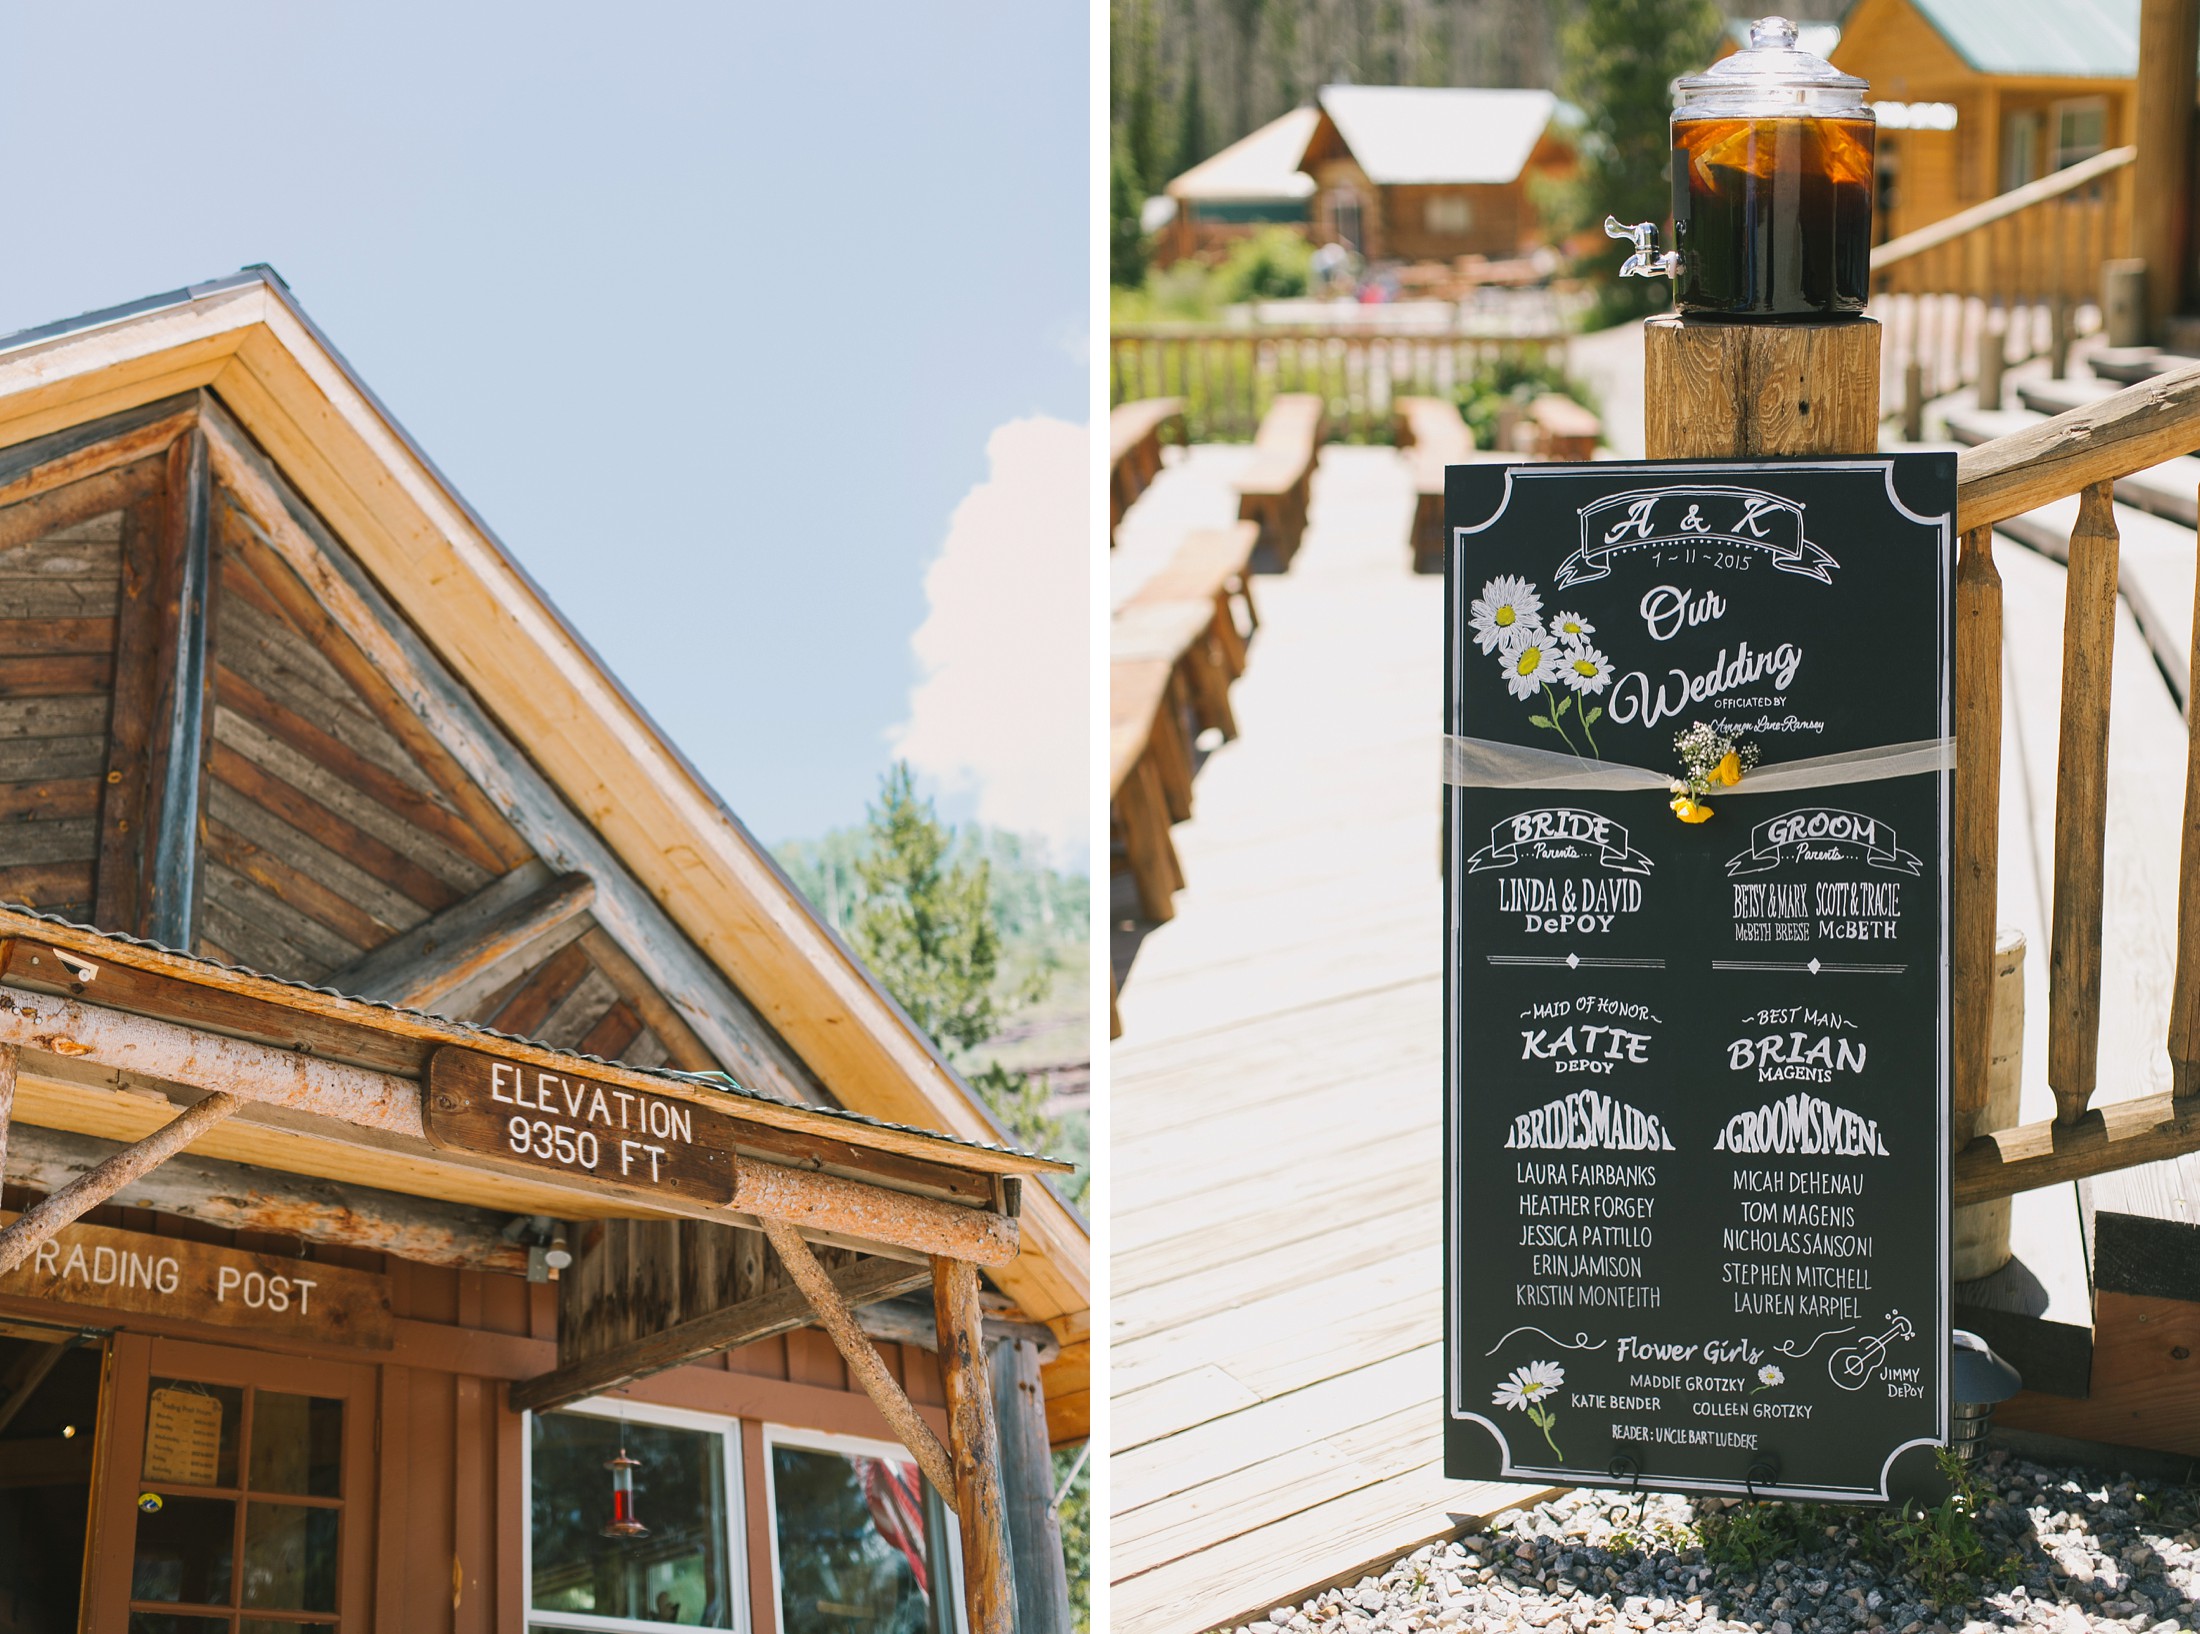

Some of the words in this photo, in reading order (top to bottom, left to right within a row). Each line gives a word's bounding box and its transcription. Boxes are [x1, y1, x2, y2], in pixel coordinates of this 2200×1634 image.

[1604, 498, 1659, 544] A
[1680, 504, 1711, 533] &
[1731, 498, 1786, 538] K
[1640, 585, 1726, 641] Our
[1608, 641, 1802, 728] Wedding
[1714, 698, 1773, 709] OFFICIATED
[1773, 696, 1787, 707] BY
[1511, 811, 1612, 844] BRIDE
[1768, 812, 1876, 845] GROOM
[1498, 878, 1558, 913] LINDA
[1562, 878, 1578, 912] &
[1582, 878, 1642, 912] DAVID
[1732, 884, 1767, 918] BETSY
[1768, 883, 1777, 918] &
[1815, 881, 1849, 917] SCOTT
[1850, 882, 1859, 916] &
[1860, 882, 1901, 917] TRACIE
[1524, 914, 1615, 934] DePOY
[1735, 922, 1772, 941] McBETH
[1775, 922, 1810, 942] BREESE
[1818, 920, 1898, 941] McBETH
[1576, 996, 1596, 1014] OF
[1521, 1025, 1652, 1063] KATIE
[1727, 1032, 1867, 1074] BRIAN
[1555, 1060, 1614, 1075] DEPOY
[1758, 1065, 1832, 1083] MAGENIS
[491, 1062, 692, 1144] ELEVATION
[1515, 1089, 1660, 1152] BRIDESMAIDS
[1726, 1092, 1878, 1156] GROOMSMEN
[509, 1116, 599, 1169] 9350
[621, 1139, 666, 1183] FT
[1517, 1162, 1568, 1186] LAURA
[1571, 1163, 1656, 1187] FAIRBANKS
[1733, 1170, 1783, 1192] MICAH
[1789, 1171, 1864, 1196] DEHENAU
[1519, 1194, 1590, 1216] HEATHER
[1594, 1196, 1655, 1219] FORGEY
[1741, 1202, 1778, 1223] TOM
[1782, 1204, 1855, 1228] MAGENIS
[1519, 1225, 1578, 1247] JESSICA
[1582, 1225, 1652, 1248] PATTILLO
[1723, 1228, 1801, 1254] NICHOLAS
[1802, 1232, 1873, 1258] SANSONI
[14, 1238, 180, 1294] RADING
[217, 1266, 318, 1315] POST
[1533, 1254, 1568, 1277] ERIN
[1570, 1254, 1642, 1278] JAMISON
[1722, 1262, 1791, 1286] STEPHEN
[1796, 1265, 1872, 1290] MITCHELL
[1516, 1284, 1574, 1307] KRISTIN
[1578, 1285, 1661, 1309] MONTEITH
[1734, 1291, 1794, 1316] LAUREN
[1799, 1294, 1862, 1320] KARPIEL
[1617, 1336, 1698, 1363] Flower
[1703, 1338, 1765, 1365] Girls
[1630, 1374, 1681, 1390] MADDIE
[1685, 1376, 1746, 1392] GROTZKY
[1879, 1366, 1920, 1383] JIMMY
[1571, 1393, 1607, 1409] KATIE
[1609, 1395, 1661, 1410] BENDER
[1692, 1402, 1749, 1417] COLLEEN
[1752, 1403, 1813, 1419] GROTZKY
[1655, 1427, 1687, 1445] UNCLE
[1688, 1430, 1715, 1445] BART
[1715, 1432, 1758, 1451] LUEDEKE
